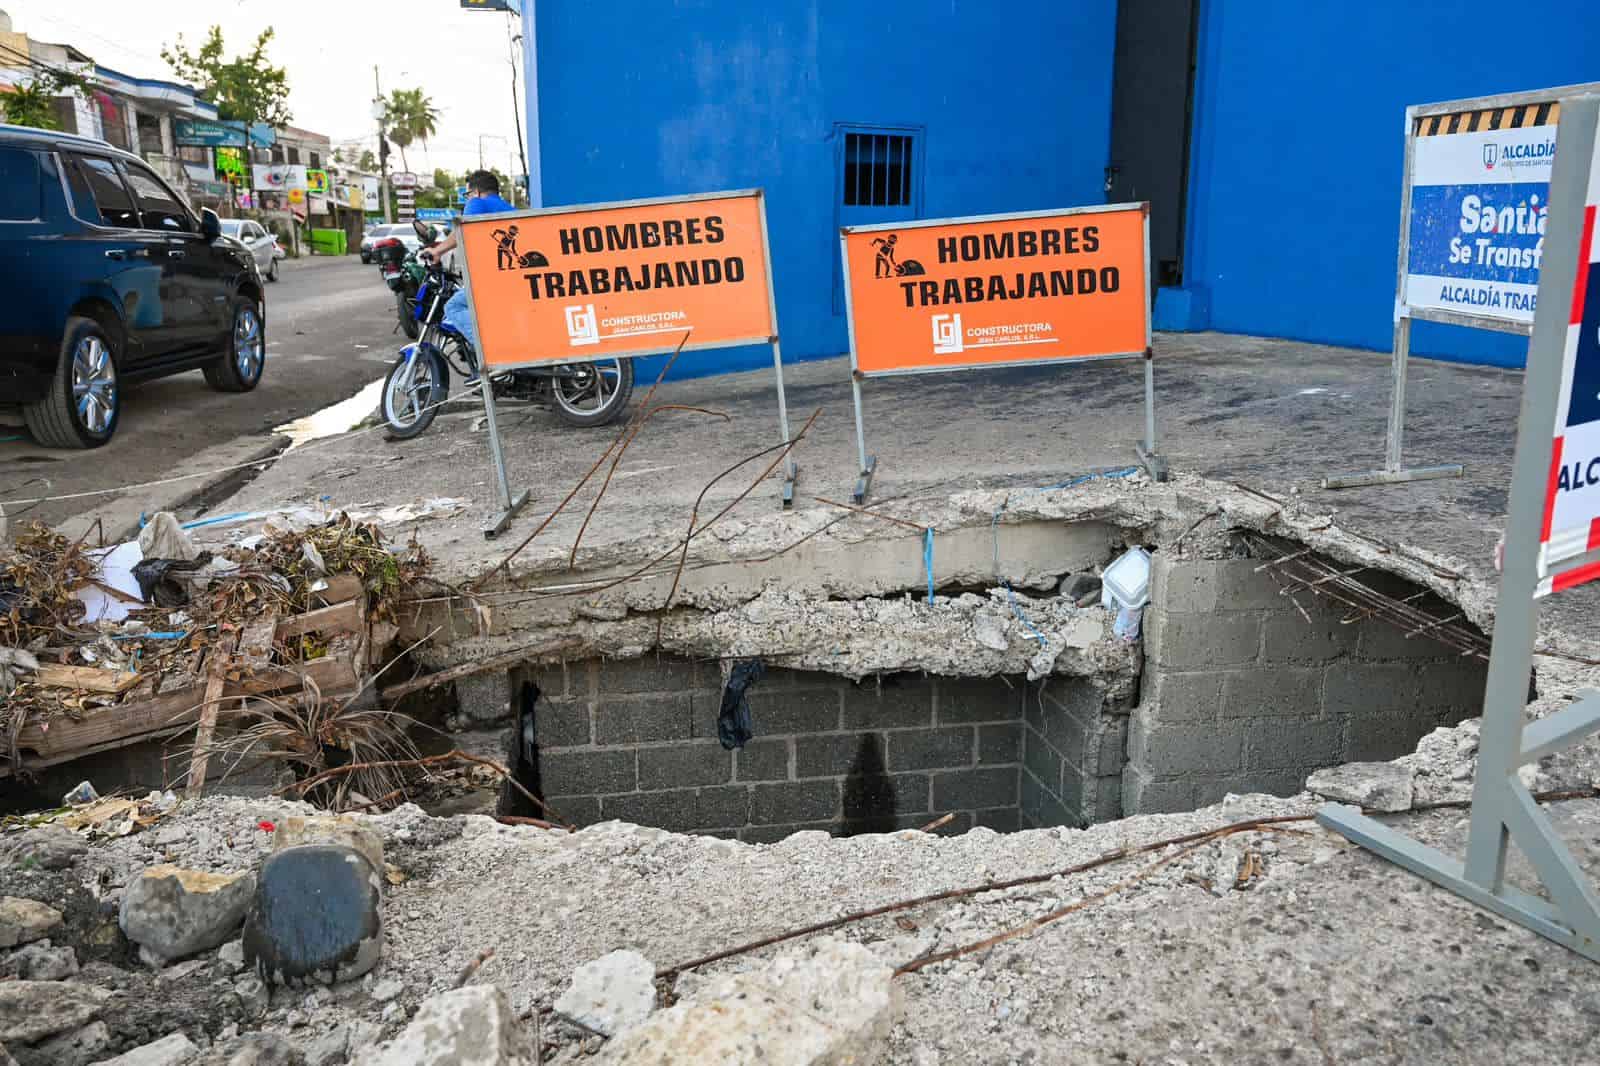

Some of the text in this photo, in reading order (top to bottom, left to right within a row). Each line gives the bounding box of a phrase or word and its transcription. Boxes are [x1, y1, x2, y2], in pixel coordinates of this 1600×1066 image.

[560, 216, 723, 254] HOMBRES
[938, 227, 1098, 263] HOMBRES
[1449, 238, 1472, 264] Se
[525, 257, 744, 299] TRABAJANDO
[901, 267, 1119, 307] TRABAJANDO
[1440, 285, 1501, 307] ALCALDÍA
[601, 311, 687, 327] CONSTRUCTORA
[967, 322, 1052, 336] CONSTRUCTORA
[1558, 456, 1600, 492] ALC
